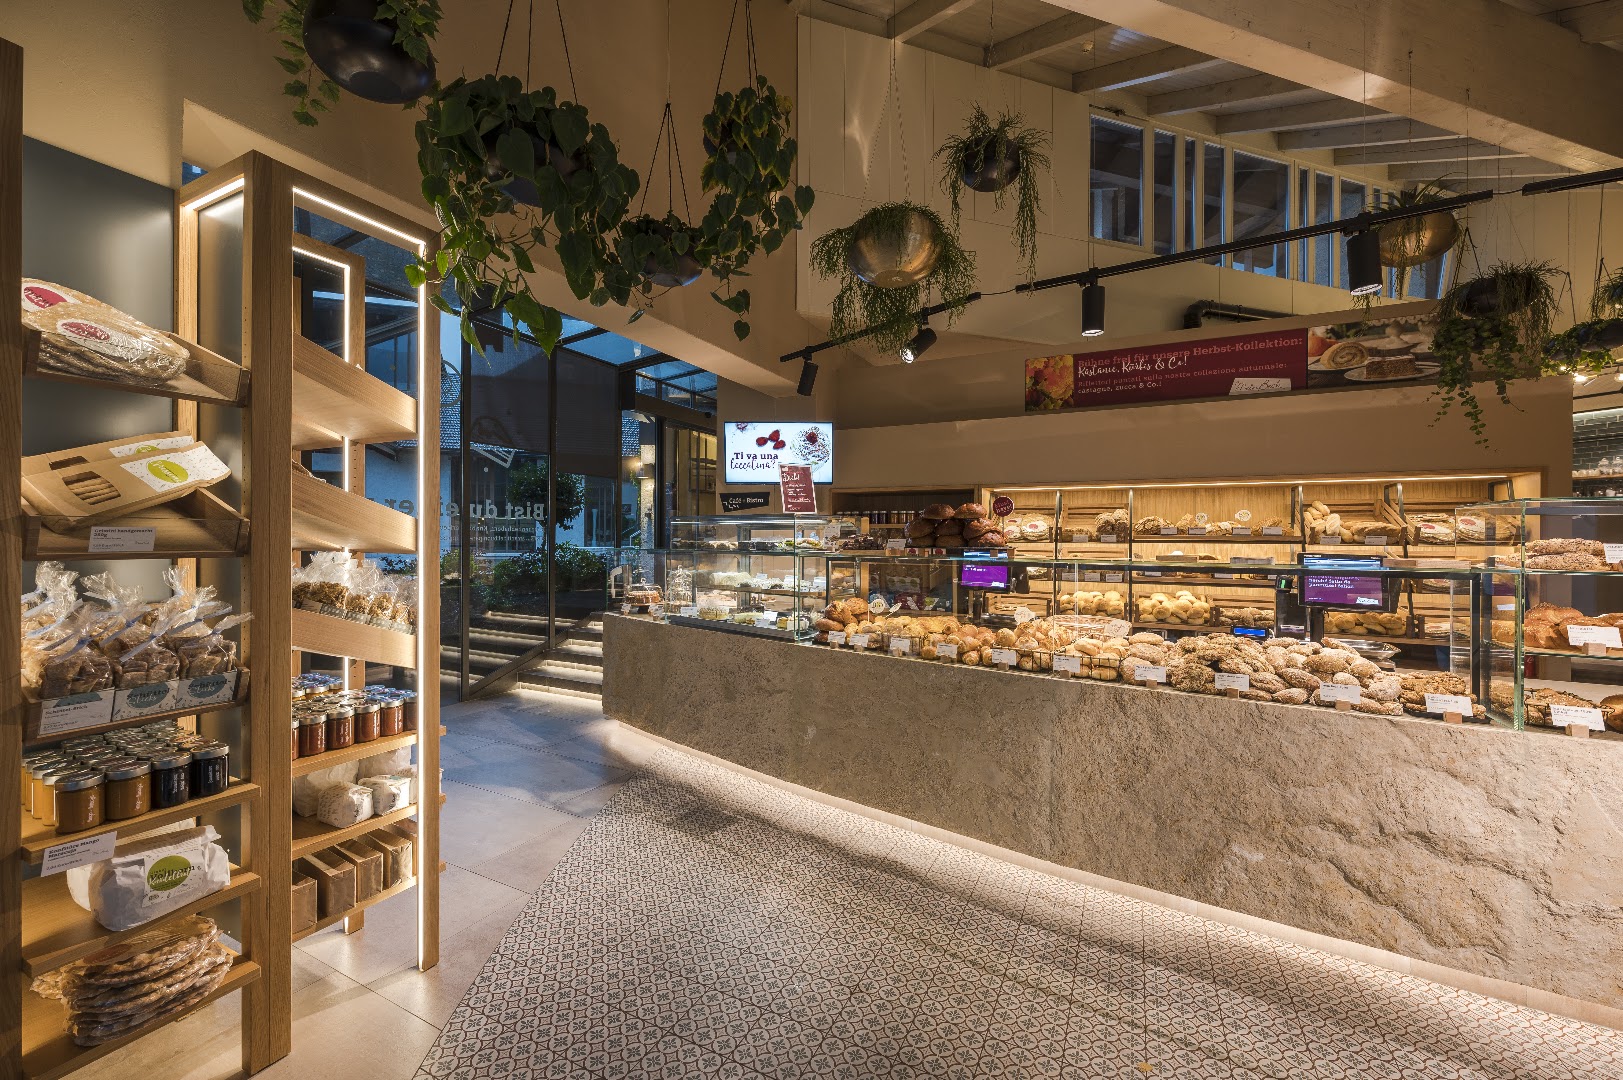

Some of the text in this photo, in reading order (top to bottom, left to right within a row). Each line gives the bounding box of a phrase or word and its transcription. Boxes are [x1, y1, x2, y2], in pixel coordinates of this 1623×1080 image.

[1078, 338, 1302, 368] Bühne frei für unsere Herbst-Kollektion:
[1154, 358, 1165, 370] &
[1165, 371, 1191, 380] nostra
[1193, 367, 1236, 377] collezione
[1115, 384, 1137, 392] zucca
[80, 838, 100, 847] Mango
